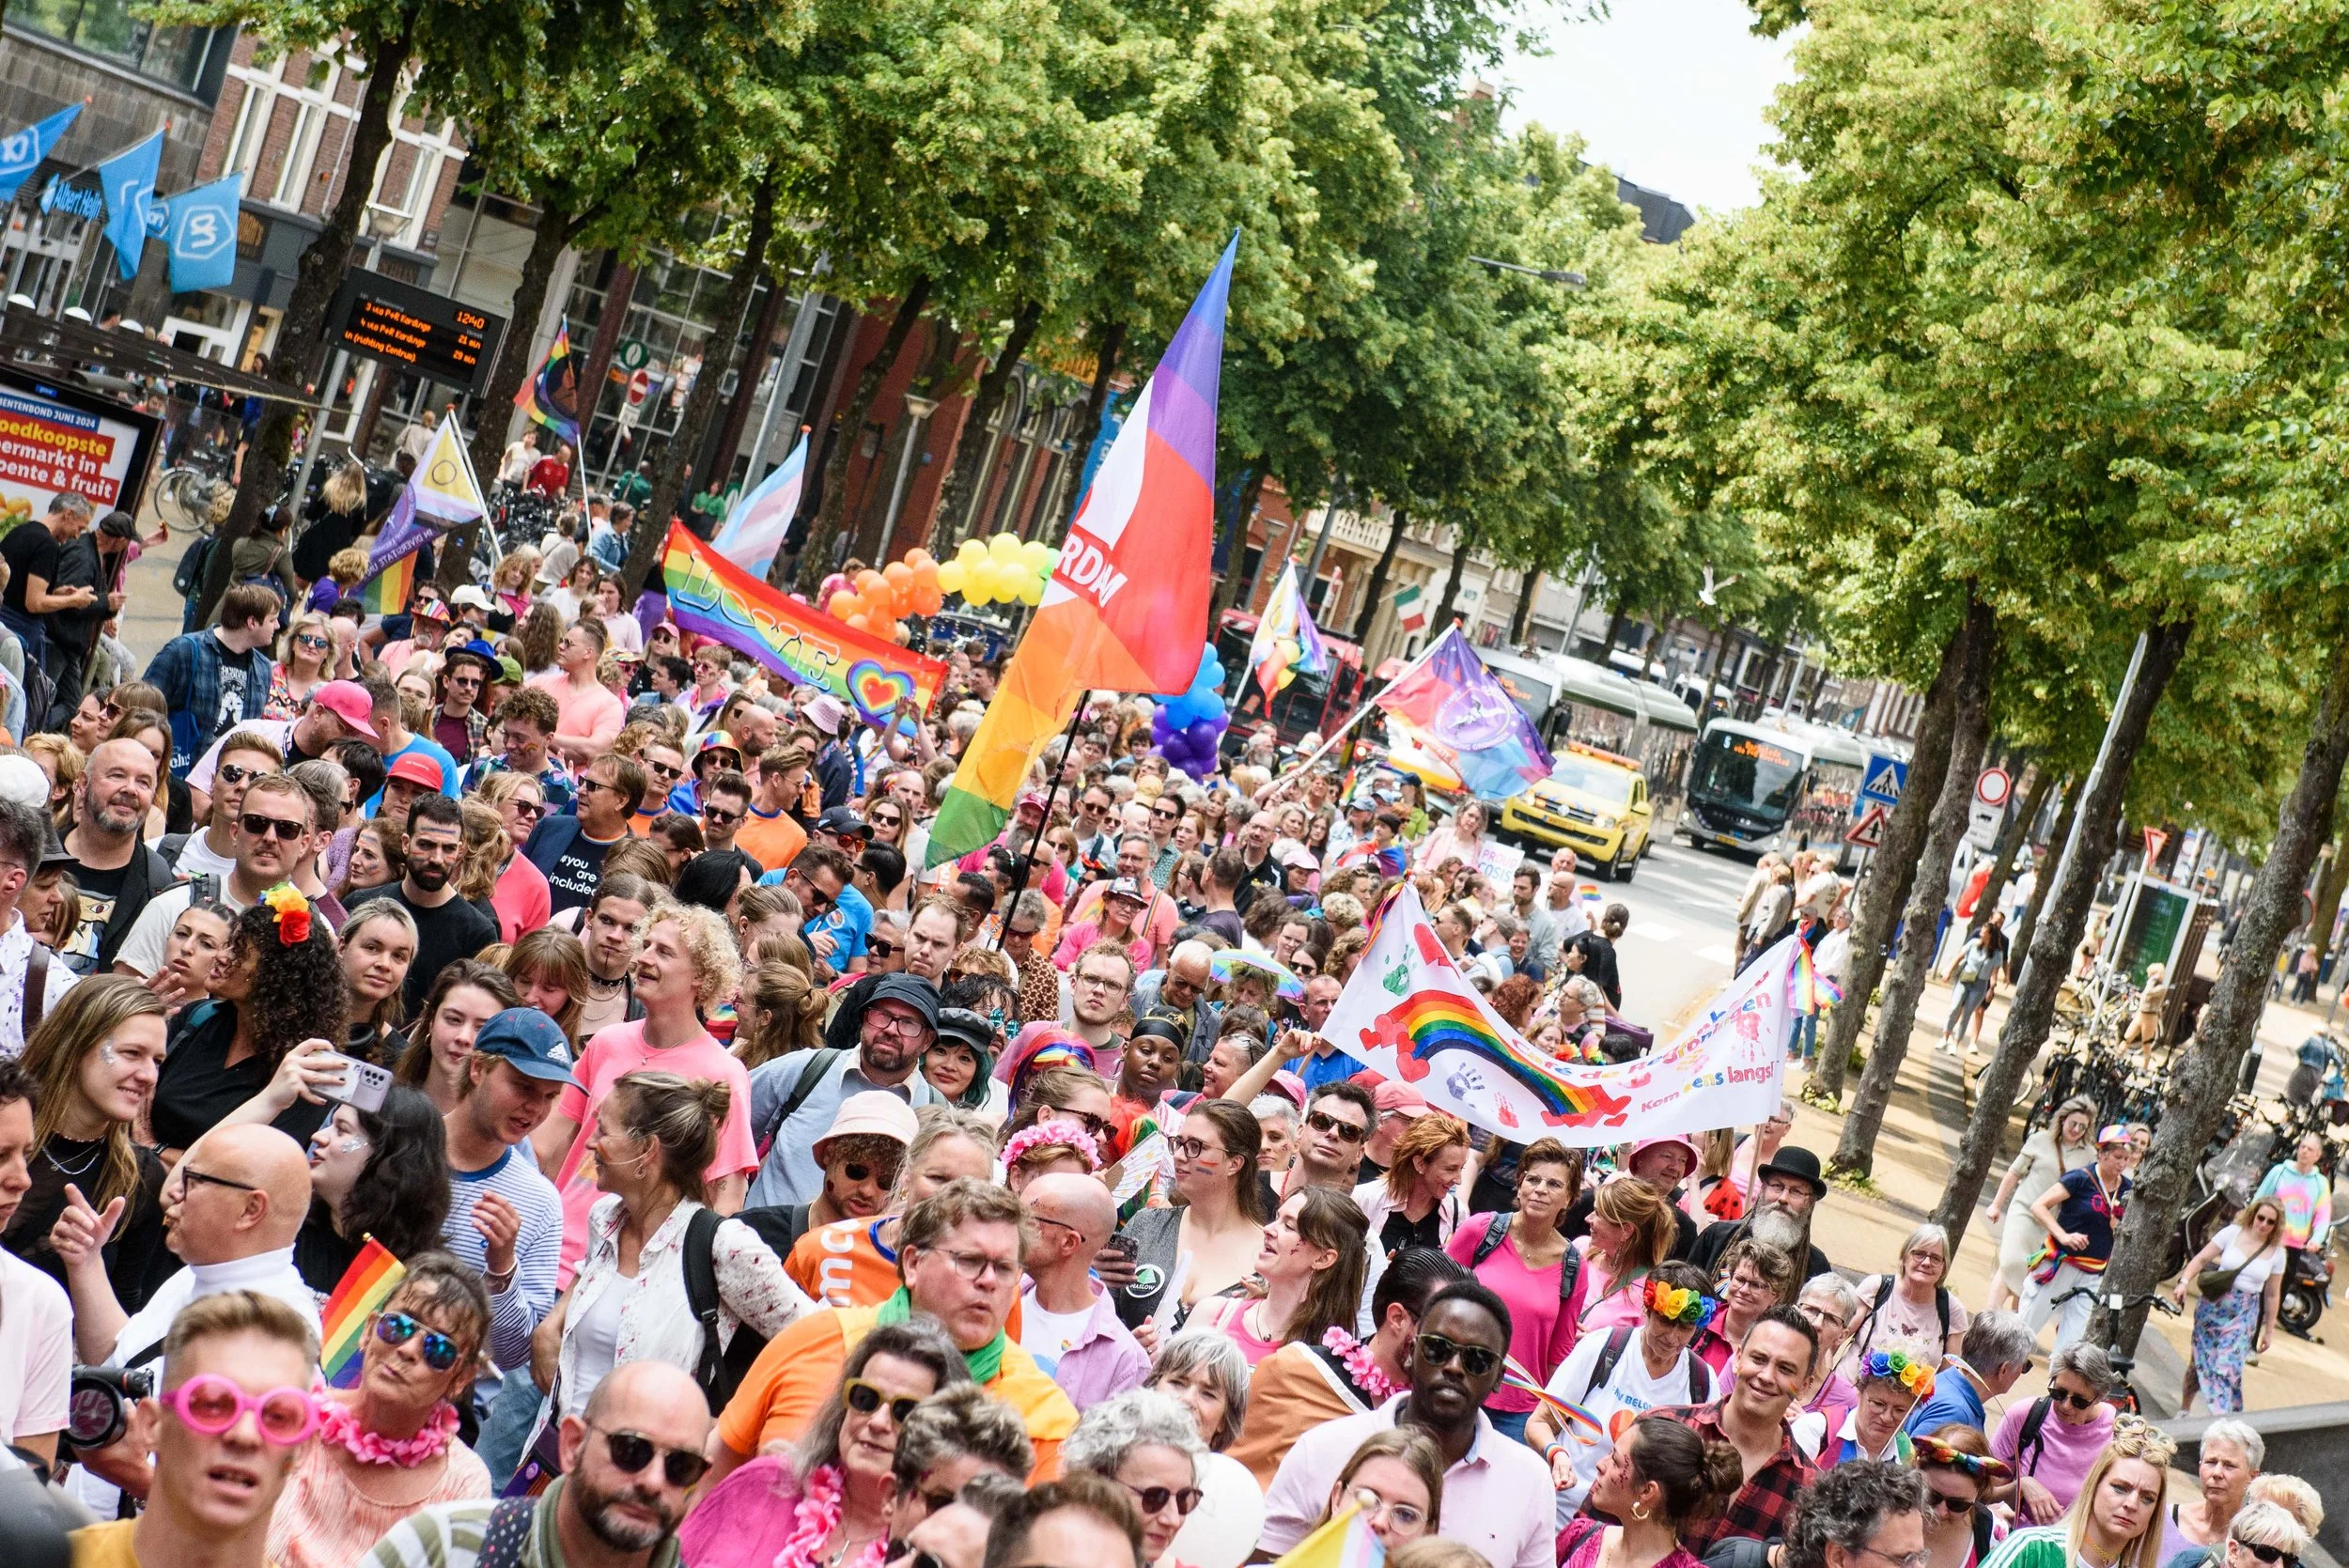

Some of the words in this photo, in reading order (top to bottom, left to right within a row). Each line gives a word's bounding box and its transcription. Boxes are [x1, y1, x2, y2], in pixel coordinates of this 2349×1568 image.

[53, 180, 83, 213] Albert
[78, 188, 102, 223] Heijn
[365, 302, 371, 312] 3
[456, 311, 485, 330] 12:40
[458, 334, 468, 345] 21
[54, 411, 75, 424] JUNI
[76, 417, 96, 428] 2024
[79, 453, 97, 474] in
[52, 470, 67, 488] &
[70, 474, 113, 499] fruit
[676, 551, 841, 692] LOVE
[560, 855, 588, 869] #you
[1482, 849, 1517, 869] PROUD
[576, 870, 597, 882] are
[1641, 1091, 1680, 1113] Kom
[1684, 1070, 1724, 1094] eens
